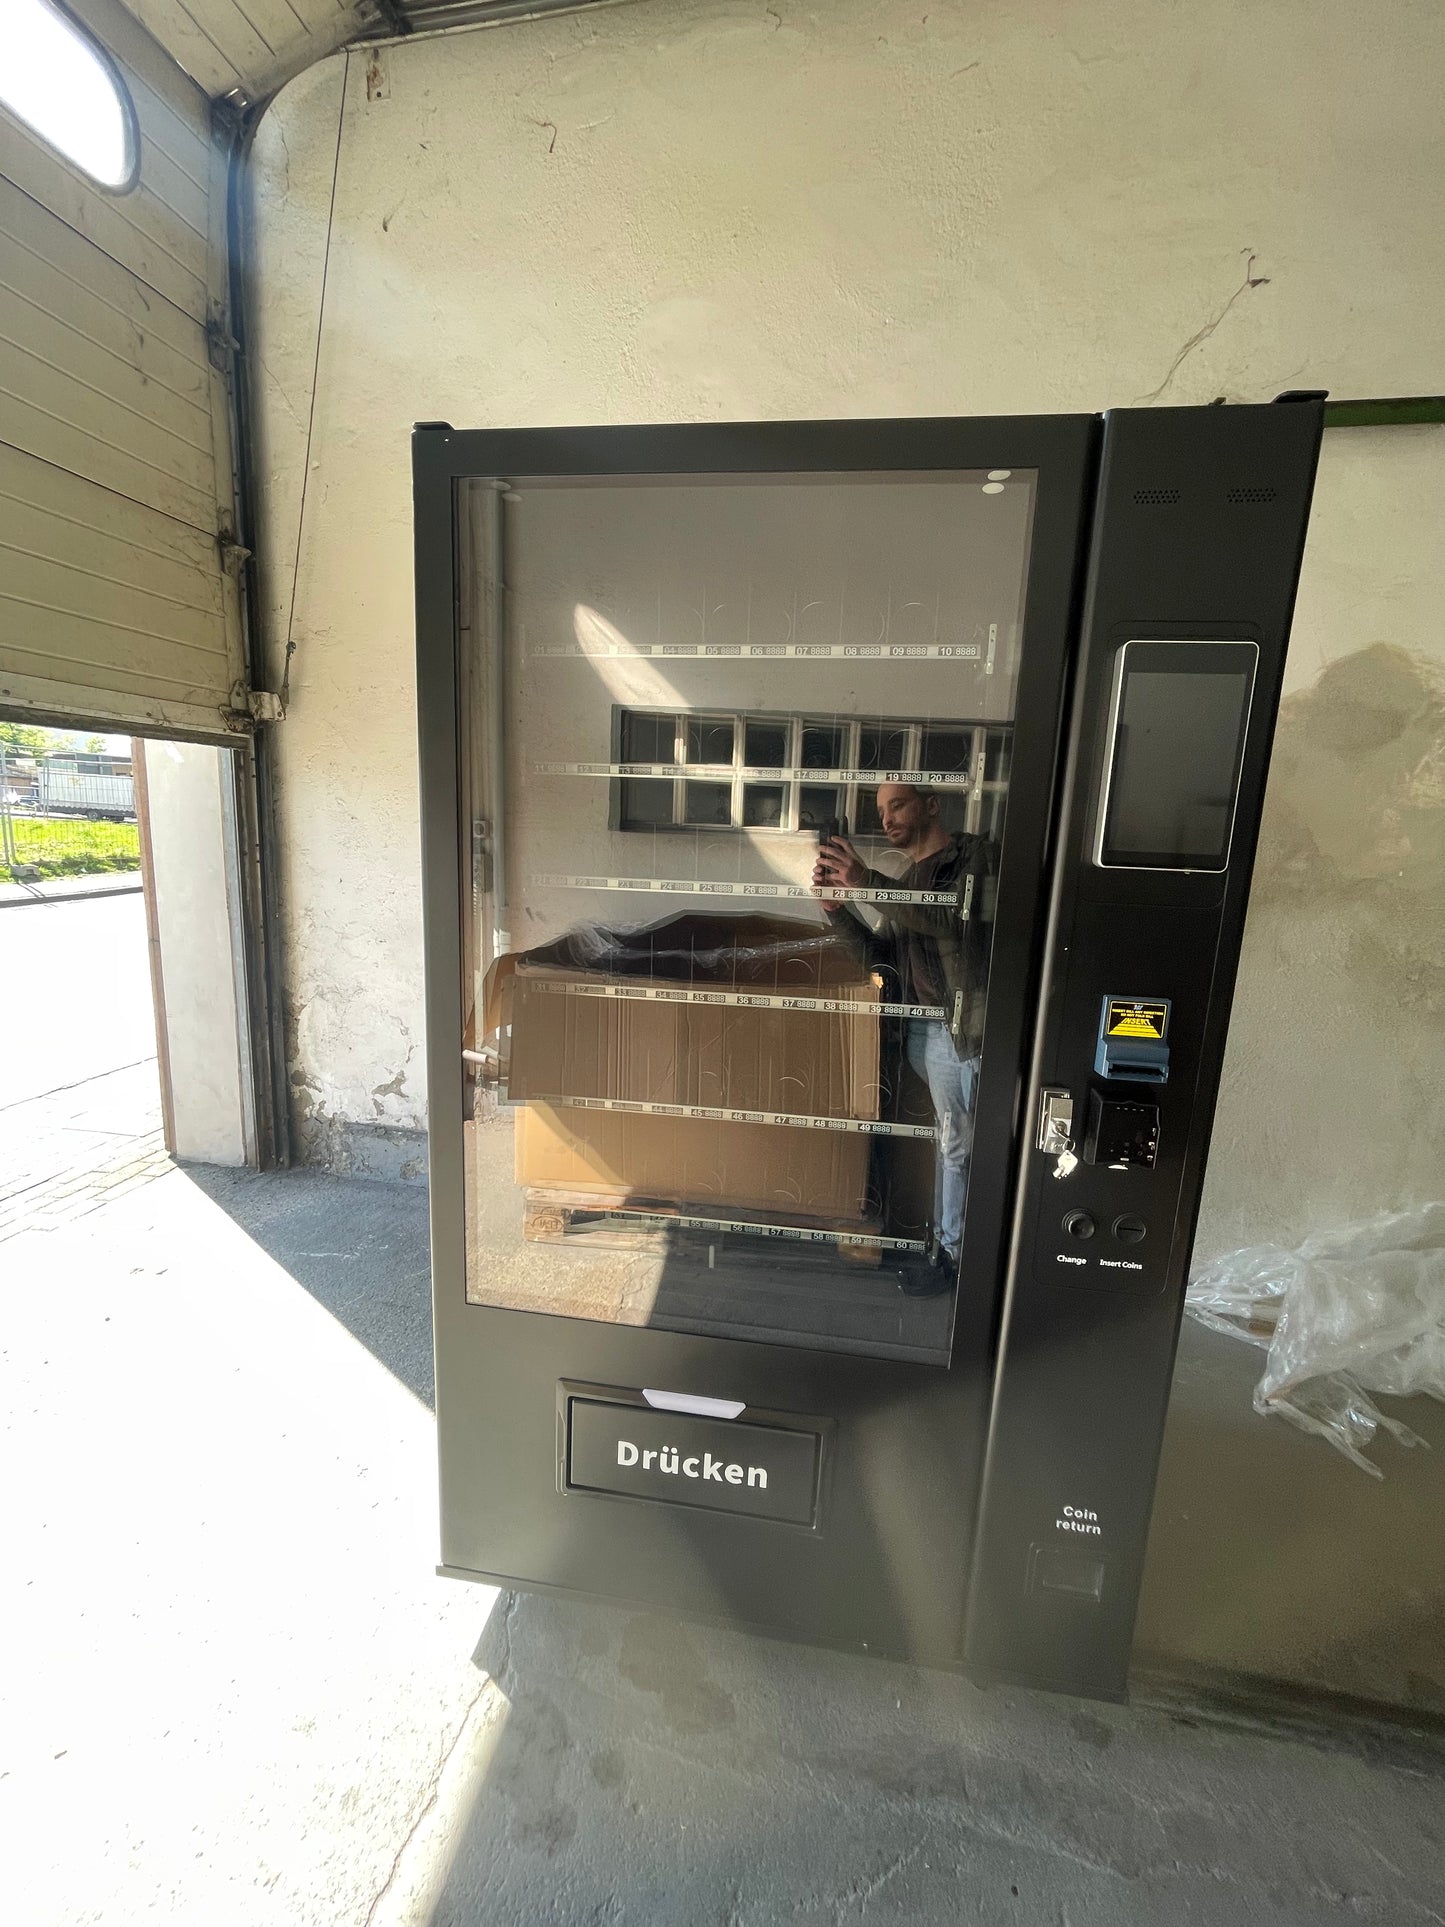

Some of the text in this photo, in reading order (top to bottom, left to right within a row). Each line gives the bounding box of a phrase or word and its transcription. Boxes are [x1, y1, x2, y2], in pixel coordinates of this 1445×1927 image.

[706, 647, 719, 655] 05
[751, 647, 763, 655] 06
[797, 647, 808, 655] 07
[810, 647, 830, 655] 8888
[762, 770, 780, 778] 8888
[809, 771, 828, 779] 8888
[842, 772, 853, 780] 18
[855, 772, 875, 780] 8888
[888, 773, 899, 781] 19
[902, 773, 921, 781] 8888
[930, 774, 942, 782] 20
[944, 774, 965, 782] 8888
[620, 880, 630, 888] 23
[675, 883, 692, 891] 8888
[701, 884, 712, 892] 25
[714, 884, 732, 892] 8888
[848, 890, 867, 898] 8888
[891, 892, 911, 901] 8888
[923, 894, 935, 902] 30
[937, 895, 957, 903] 8888
[694, 993, 705, 1001] 35
[707, 994, 725, 1002] 8888
[738, 996, 749, 1004] 36
[752, 997, 769, 1005] 8888
[784, 999, 794, 1007] 37
[797, 1000, 815, 1008] 8888
[825, 1002, 836, 1010] 38
[839, 1003, 857, 1011] 8888
[884, 1006, 903, 1014] 8888
[911, 1008, 923, 1016] 40
[925, 1009, 944, 1017] 8888
[1121, 1018, 1151, 1026] INSERT
[789, 1117, 806, 1125] 8888
[828, 1121, 847, 1129] 8888
[859, 1123, 871, 1131] 49
[873, 1125, 891, 1133] 8888
[915, 1128, 934, 1136] 8888
[813, 1232, 824, 1240] 58
[851, 1236, 862, 1244] 59
[896, 1241, 907, 1249] 60
[1056, 1254, 1087, 1266] Change
[1100, 1259, 1143, 1270] Insert Coins
[617, 1440, 769, 1489] Drücken
[1063, 1506, 1098, 1521] Coin
[1056, 1520, 1101, 1535] return
